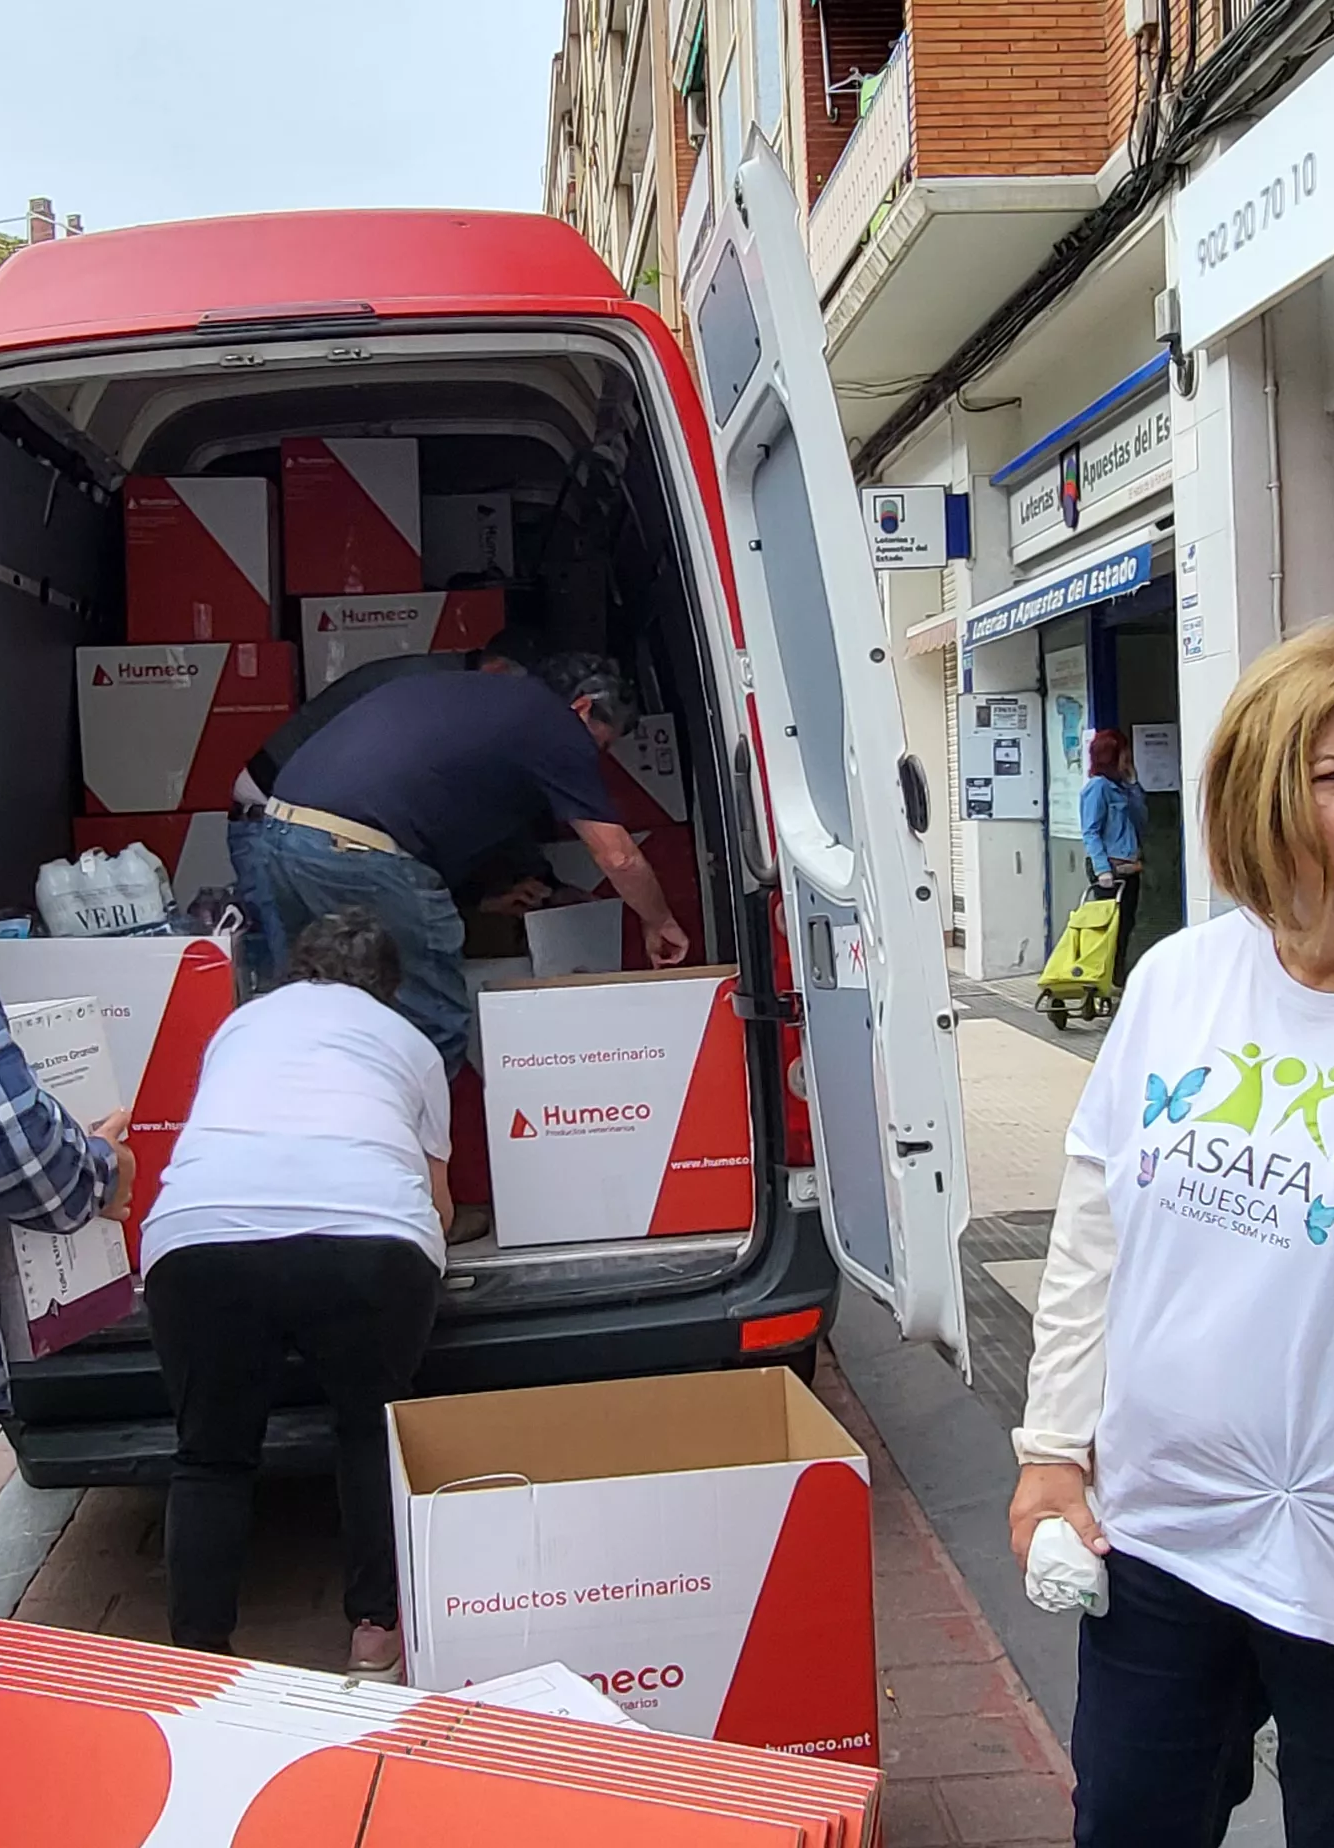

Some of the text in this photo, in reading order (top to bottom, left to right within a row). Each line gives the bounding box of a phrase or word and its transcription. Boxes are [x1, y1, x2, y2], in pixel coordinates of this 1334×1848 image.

[1197, 152, 1316, 277] 902 20 70 10
[1020, 486, 1054, 525] Loterías
[1082, 441, 1131, 492] Apuestas
[1134, 418, 1152, 458] del
[1015, 585, 1066, 626] Apuestas
[1067, 573, 1086, 603] del
[1089, 556, 1138, 595] Estado
[342, 608, 419, 624] Humeco
[118, 662, 199, 678] Humeco
[501, 1045, 666, 1069] Productos veterinarios
[542, 1102, 651, 1127] Humeco
[1163, 1129, 1312, 1204] ASAFA
[1177, 1177, 1279, 1229] HUESCA
[1230, 1220, 1259, 1239] SQM
[1269, 1232, 1291, 1249] EHS
[445, 1571, 713, 1618] Productos veterinarios
